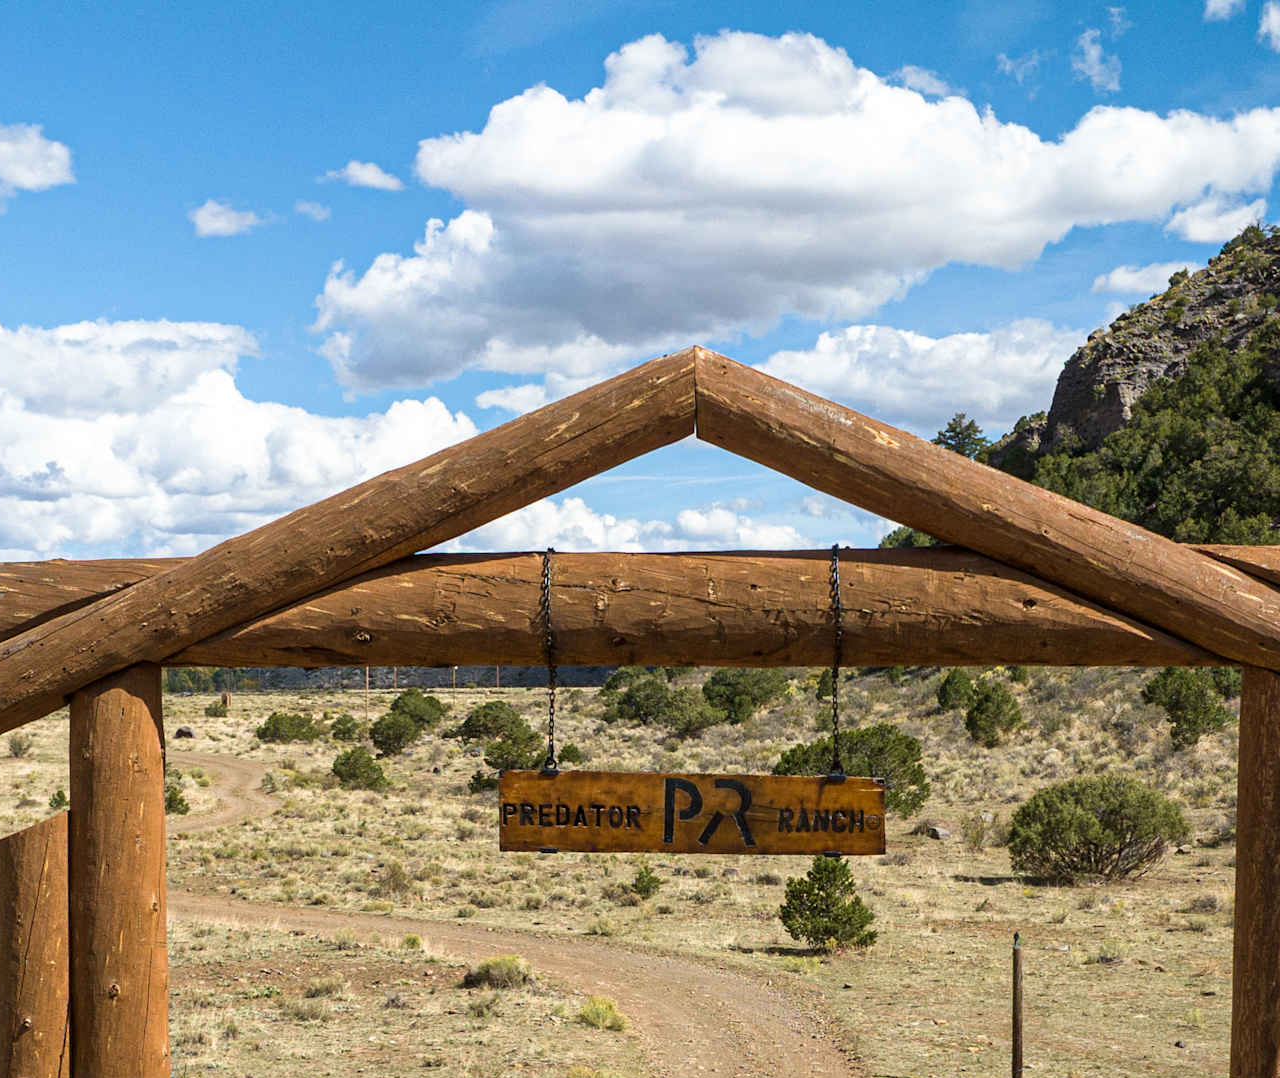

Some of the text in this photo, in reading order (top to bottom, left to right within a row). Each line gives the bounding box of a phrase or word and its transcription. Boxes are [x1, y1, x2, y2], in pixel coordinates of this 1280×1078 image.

[502, 778, 864, 846] PREDATOR PR RANCH
